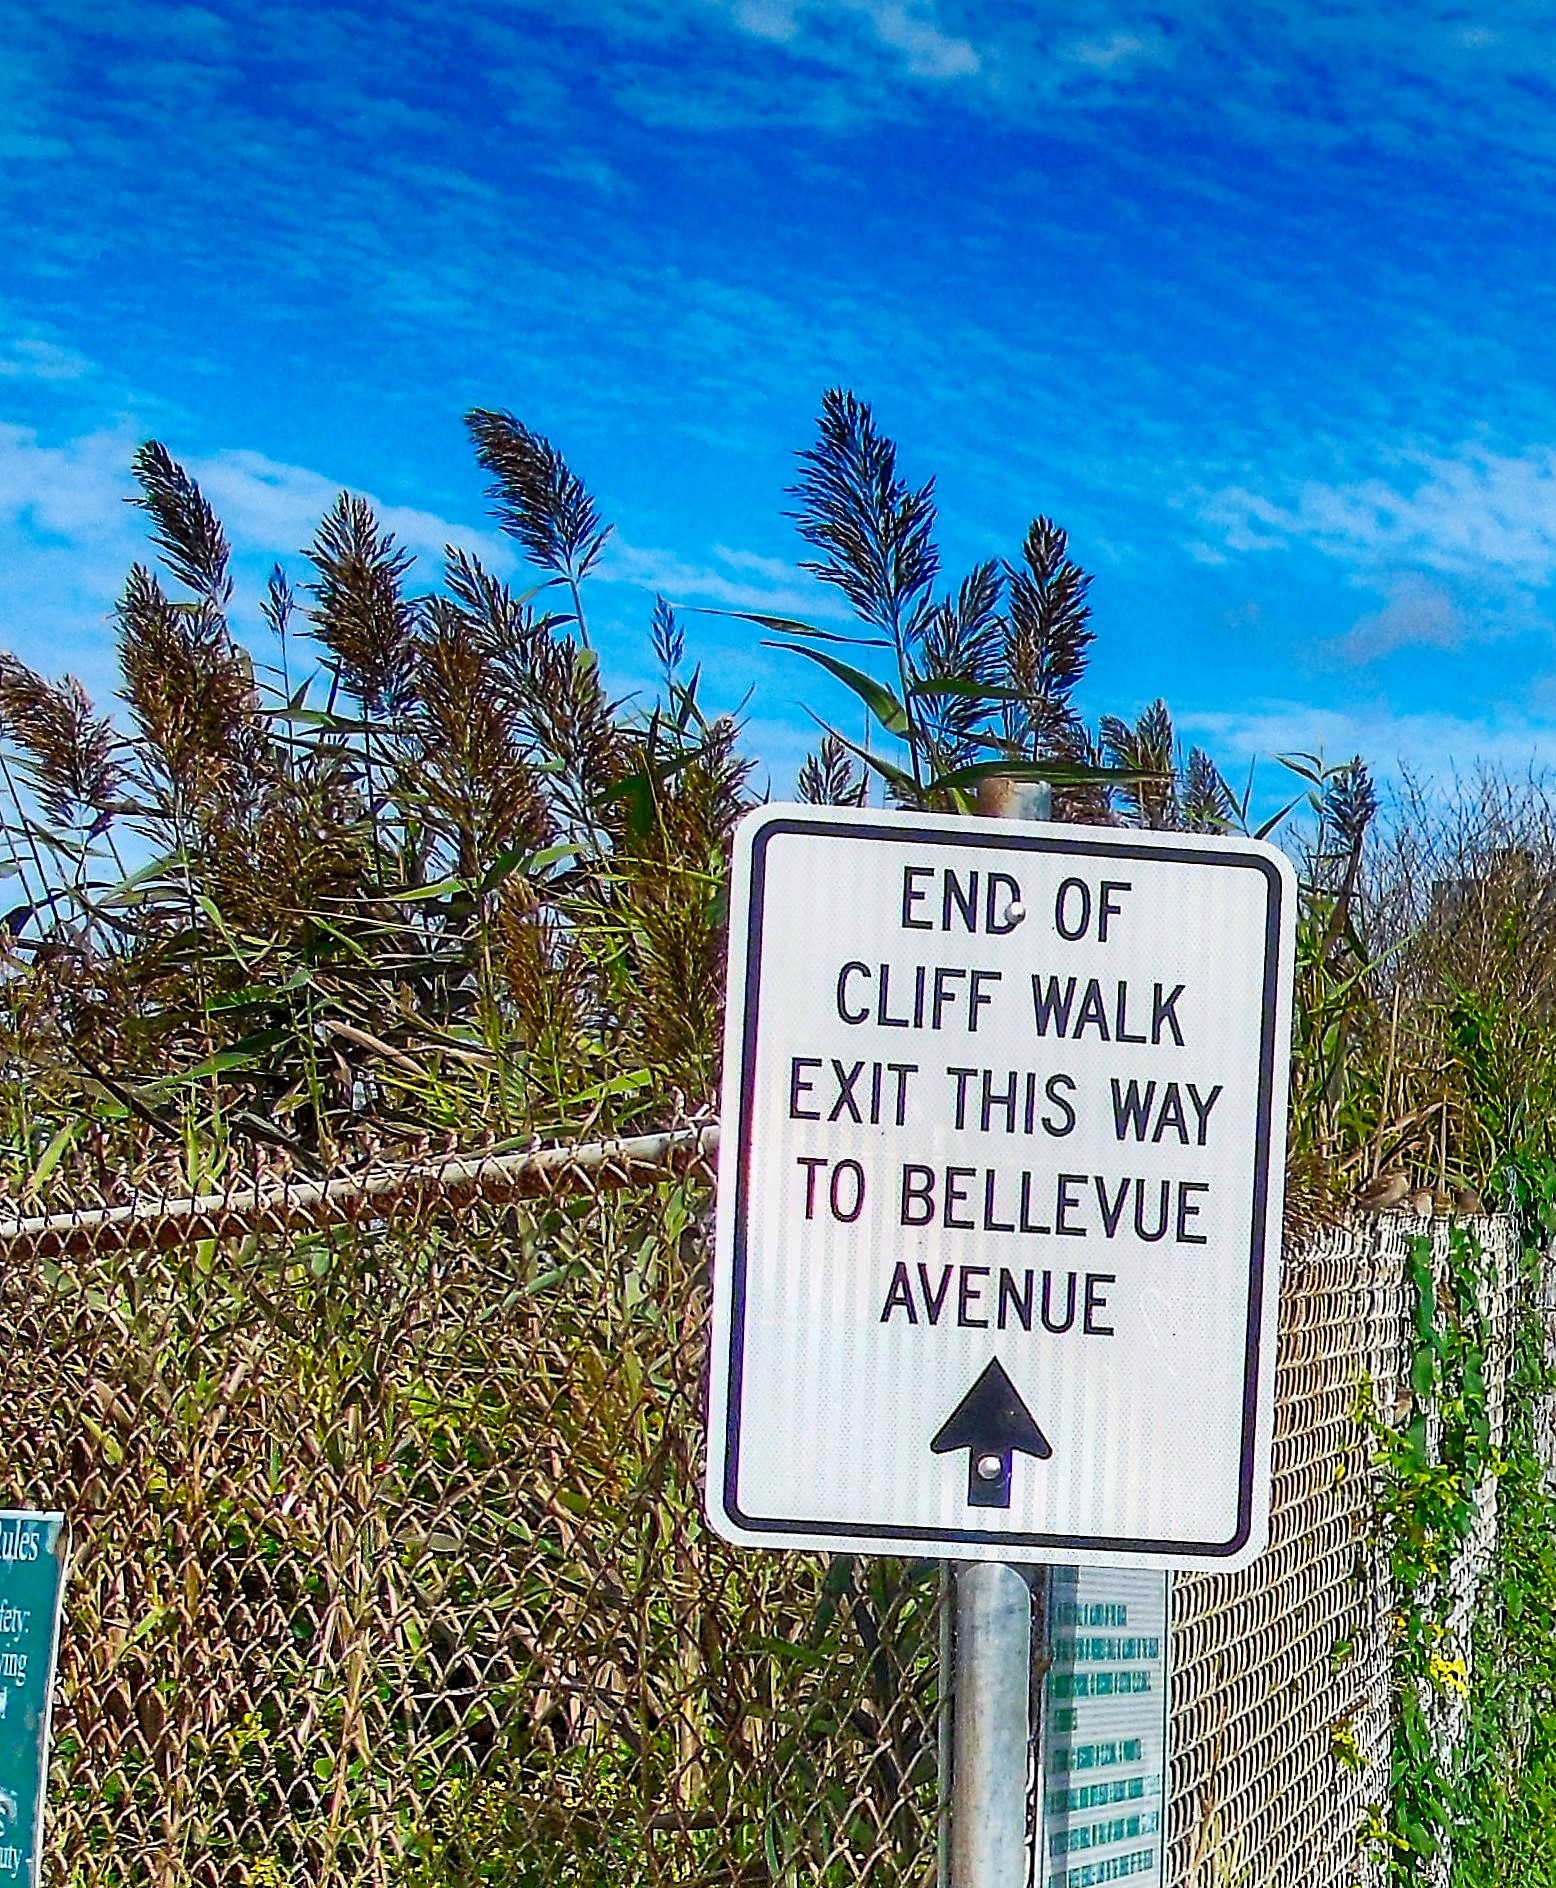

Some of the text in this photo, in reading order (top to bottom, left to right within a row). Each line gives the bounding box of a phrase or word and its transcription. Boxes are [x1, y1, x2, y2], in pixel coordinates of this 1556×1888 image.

[901, 865, 1132, 943] END OF
[836, 960, 1186, 1047] CLIFF WALK
[789, 1056, 1224, 1147] EXIT THIS WAY
[796, 1156, 1210, 1245] TO BELLEVUE
[879, 1261, 1116, 1337] AVENUE
[0, 1520, 40, 1561] ules
[0, 1599, 31, 1643] fety:
